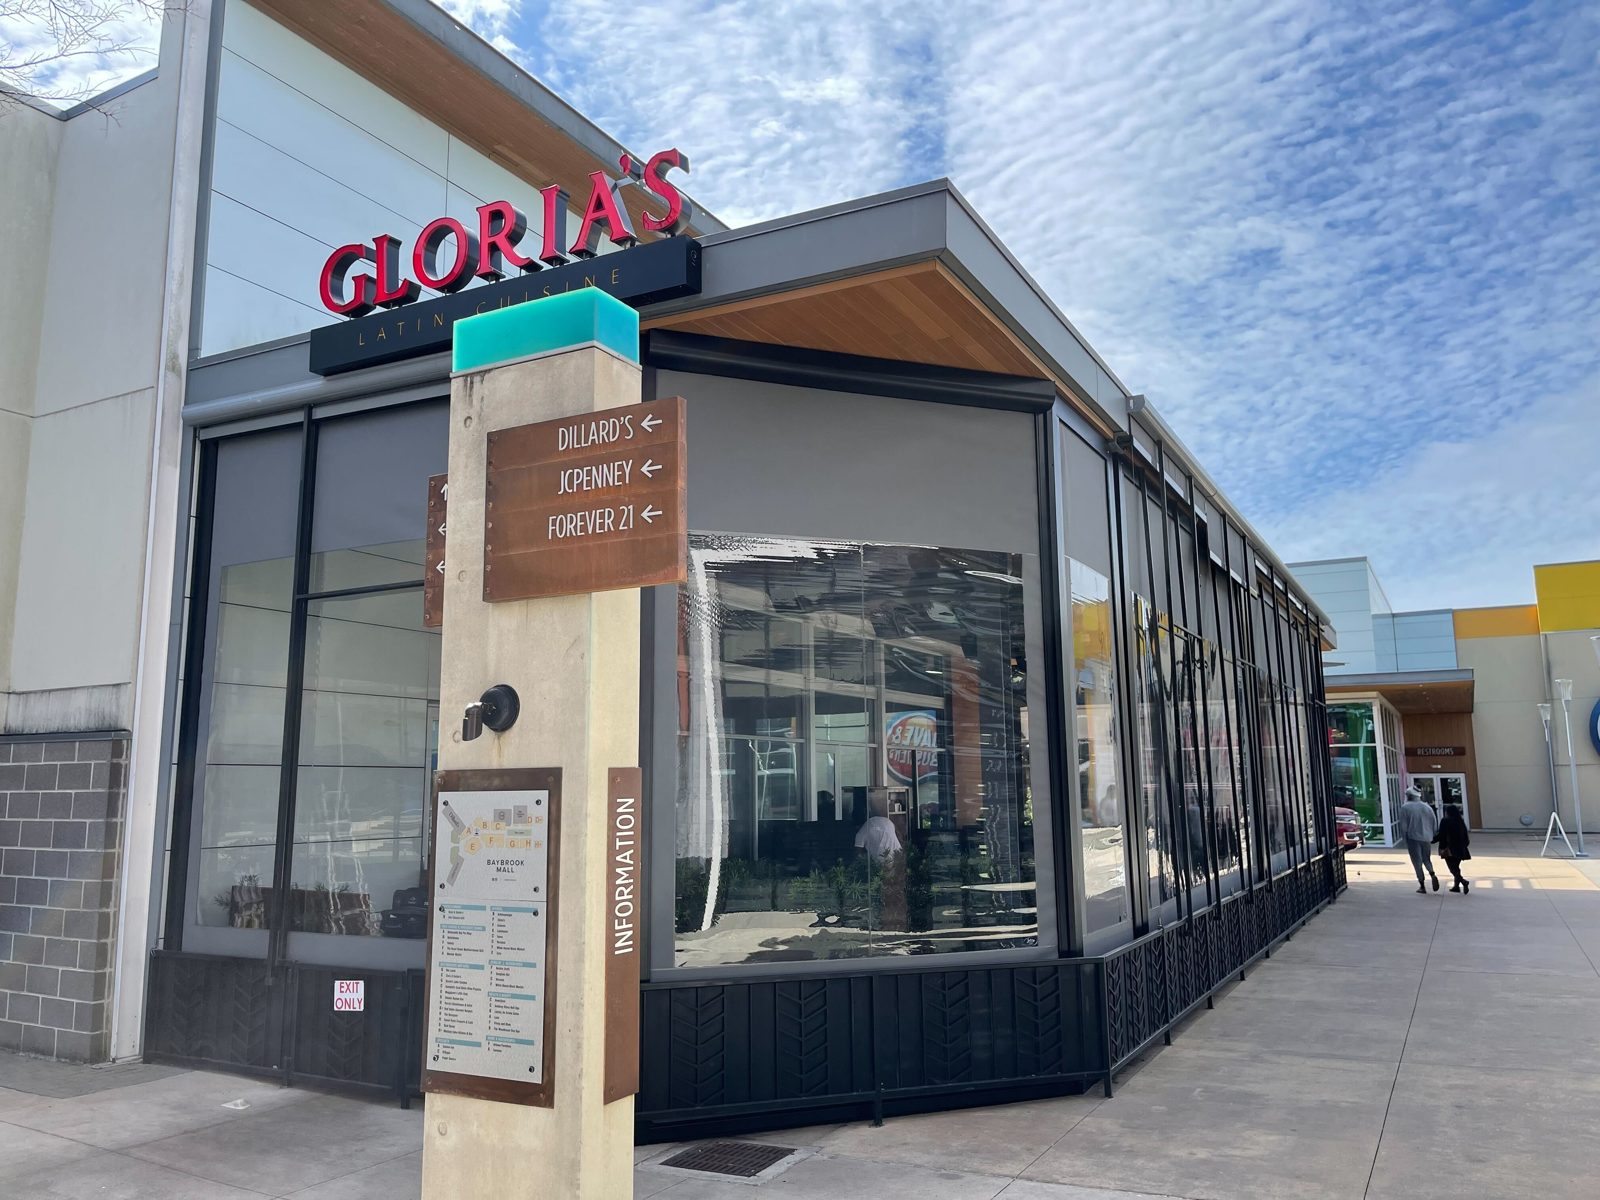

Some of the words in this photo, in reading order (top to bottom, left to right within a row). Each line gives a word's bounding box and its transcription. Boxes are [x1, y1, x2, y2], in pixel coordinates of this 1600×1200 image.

[319, 148, 685, 316] GLORIA'S
[358, 312, 444, 346] LATIN
[558, 415, 634, 451] DILLARD'S
[558, 459, 633, 495] JCPENNEY
[548, 507, 614, 540] FOREVER
[618, 505, 634, 530] 21
[1417, 747, 1454, 756] RESTROOMS
[614, 797, 635, 955] INFORMATION
[335, 997, 363, 1010] ONLY
[339, 981, 360, 994] EXIT
